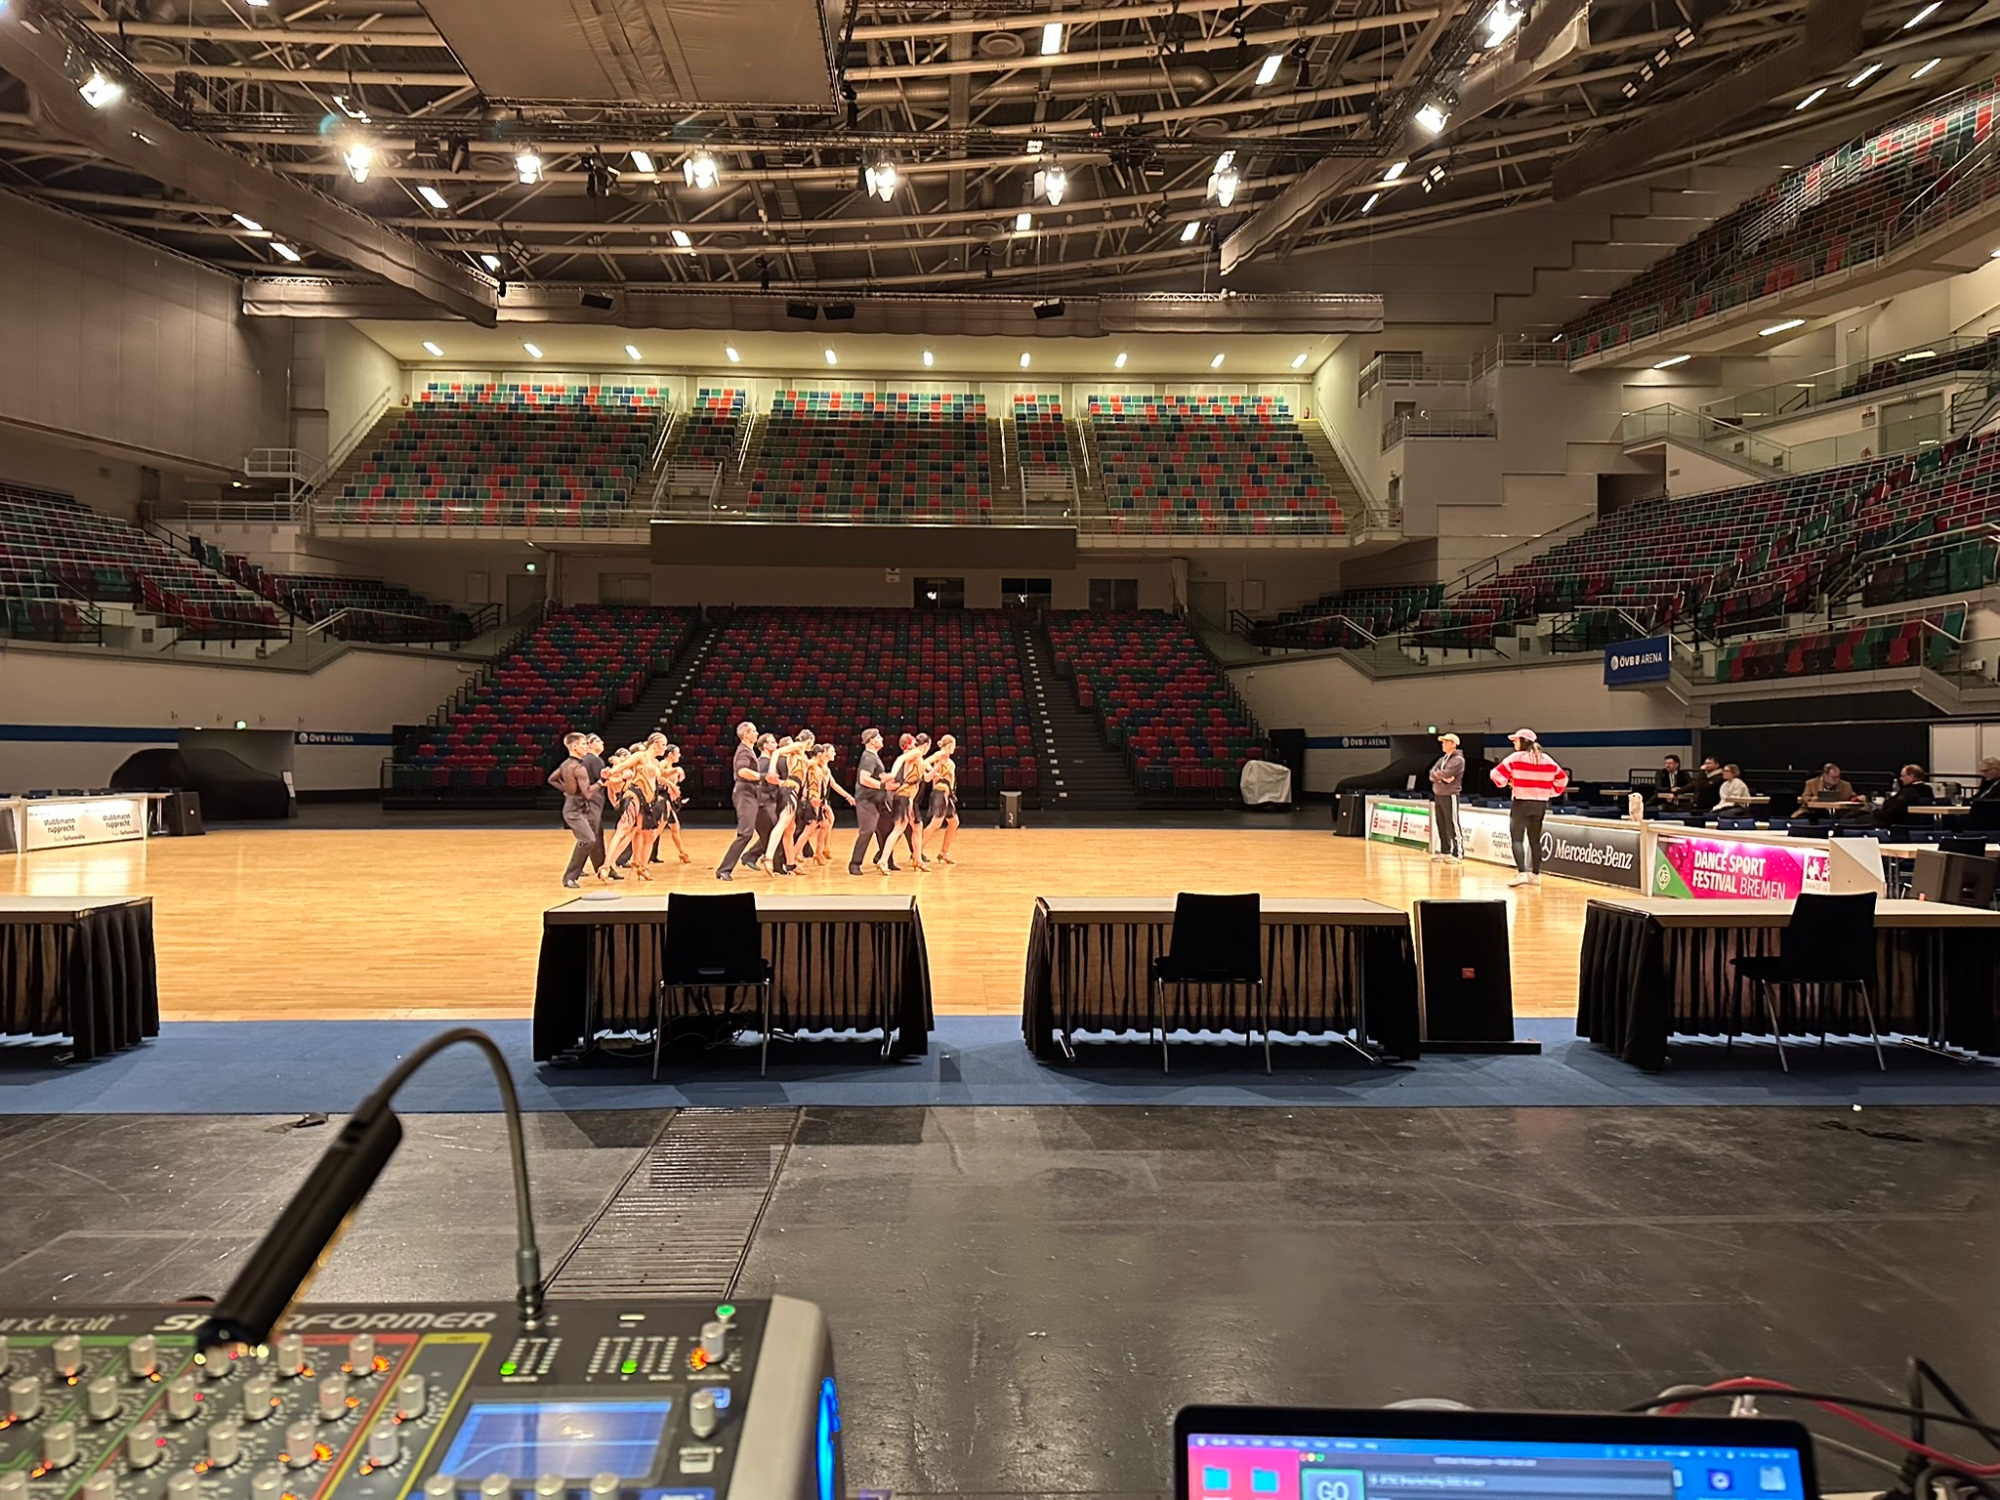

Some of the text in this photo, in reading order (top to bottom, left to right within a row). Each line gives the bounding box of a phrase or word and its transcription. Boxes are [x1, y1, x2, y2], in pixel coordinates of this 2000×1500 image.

[1640, 652, 1663, 665] ARENA
[332, 735, 354, 743] ARENA
[1368, 738, 1387, 746] ARENA
[47, 824, 75, 833] rupprecht
[1554, 838, 1634, 870] Mercedes-Benz
[1693, 850, 1767, 878] DANCE SPORT
[1691, 869, 1786, 900] FESTIVAL BREMEN
[283, 1312, 497, 1330] RFORMER
[1316, 1479, 1350, 1500] GO
